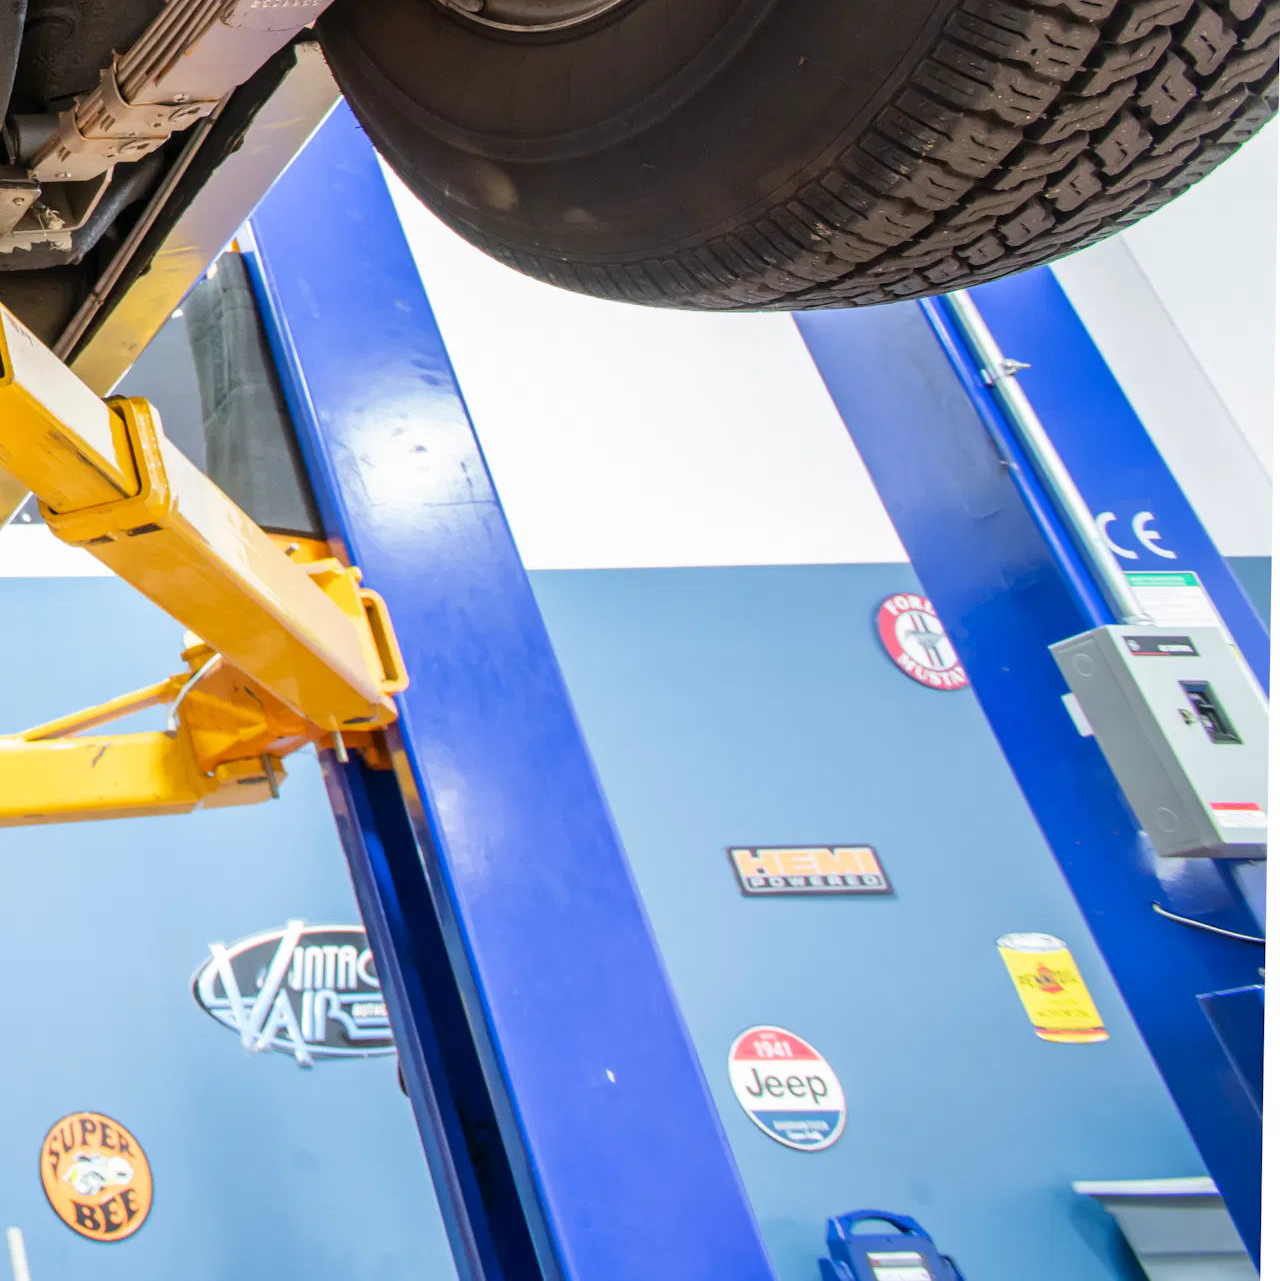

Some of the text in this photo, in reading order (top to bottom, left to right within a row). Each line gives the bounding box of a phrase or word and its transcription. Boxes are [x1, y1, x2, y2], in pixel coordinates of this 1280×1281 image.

[897, 652, 966, 687] MUSTA
[733, 848, 882, 876] HEMI
[748, 875, 883, 888] POWERED
[753, 1040, 794, 1058] 1941
[745, 1067, 828, 1105] Jeep
[48, 1117, 136, 1183] SUPER
[70, 1187, 139, 1233] BEE
